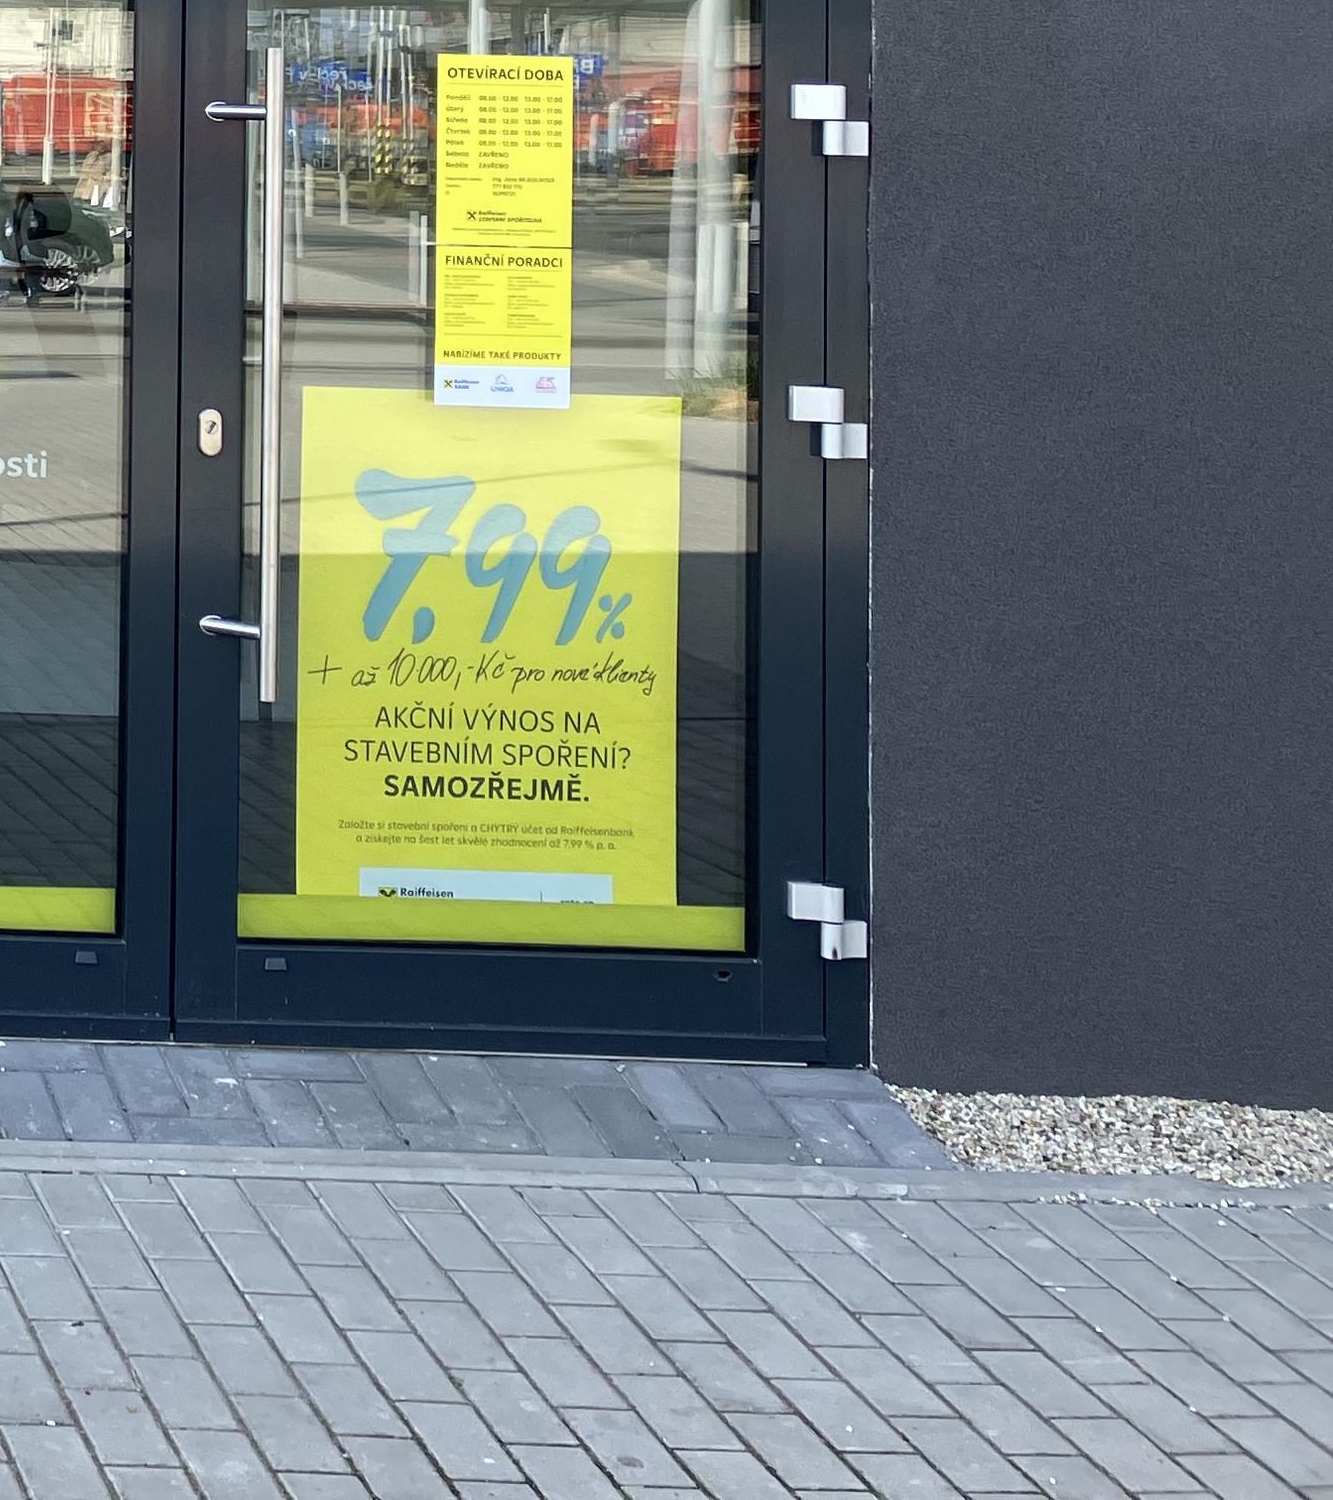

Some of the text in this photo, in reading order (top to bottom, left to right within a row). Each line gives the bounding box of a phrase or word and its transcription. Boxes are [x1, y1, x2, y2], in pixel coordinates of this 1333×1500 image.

[447, 65, 564, 81] OTEVÍRACÍ DOBA
[445, 253, 563, 268] FINANČNÍ PORADCI
[443, 349, 561, 360] NABÍZÍME TAKÉ PRODUKTY
[351, 666, 380, 687] až
[511, 665, 546, 694] pro
[374, 701, 601, 734] AKČNÍ VÝNOS NA
[344, 737, 632, 770] STAVEBNÍM SPOŘENÍ?
[383, 772, 590, 802] SAMOZŘEJMĚ.
[338, 819, 376, 830] Založte
[377, 821, 385, 830] si
[387, 821, 430, 832] stavební
[432, 822, 469, 834] spoření
[480, 822, 518, 833] CHYTRÝ
[521, 823, 543, 835] účet
[545, 825, 558, 835] od
[365, 833, 402, 846] získejte
[404, 835, 416, 844] na
[418, 834, 440, 845] šest
[441, 835, 455, 846] let
[457, 835, 488, 847] skvělé
[491, 836, 547, 848] zhodnocení
[400, 887, 454, 899] Raiffeisen
